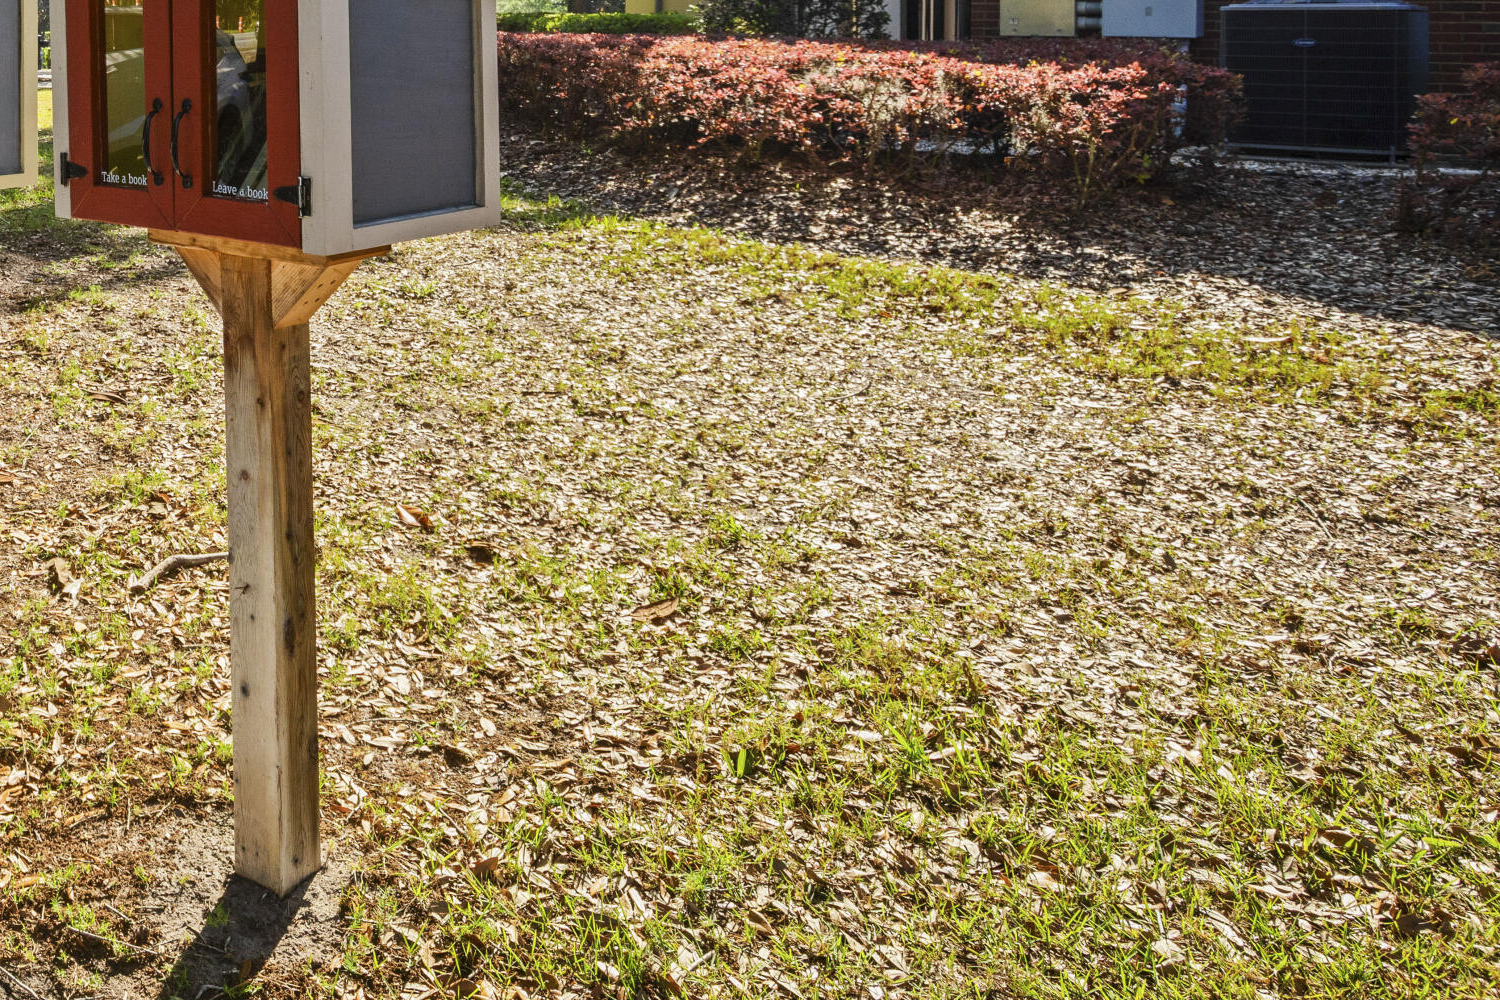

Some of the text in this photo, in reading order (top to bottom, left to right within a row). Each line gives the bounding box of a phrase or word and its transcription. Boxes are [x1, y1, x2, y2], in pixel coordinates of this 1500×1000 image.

[102, 171, 148, 186] Take a book
[212, 181, 268, 200] Leave a book
